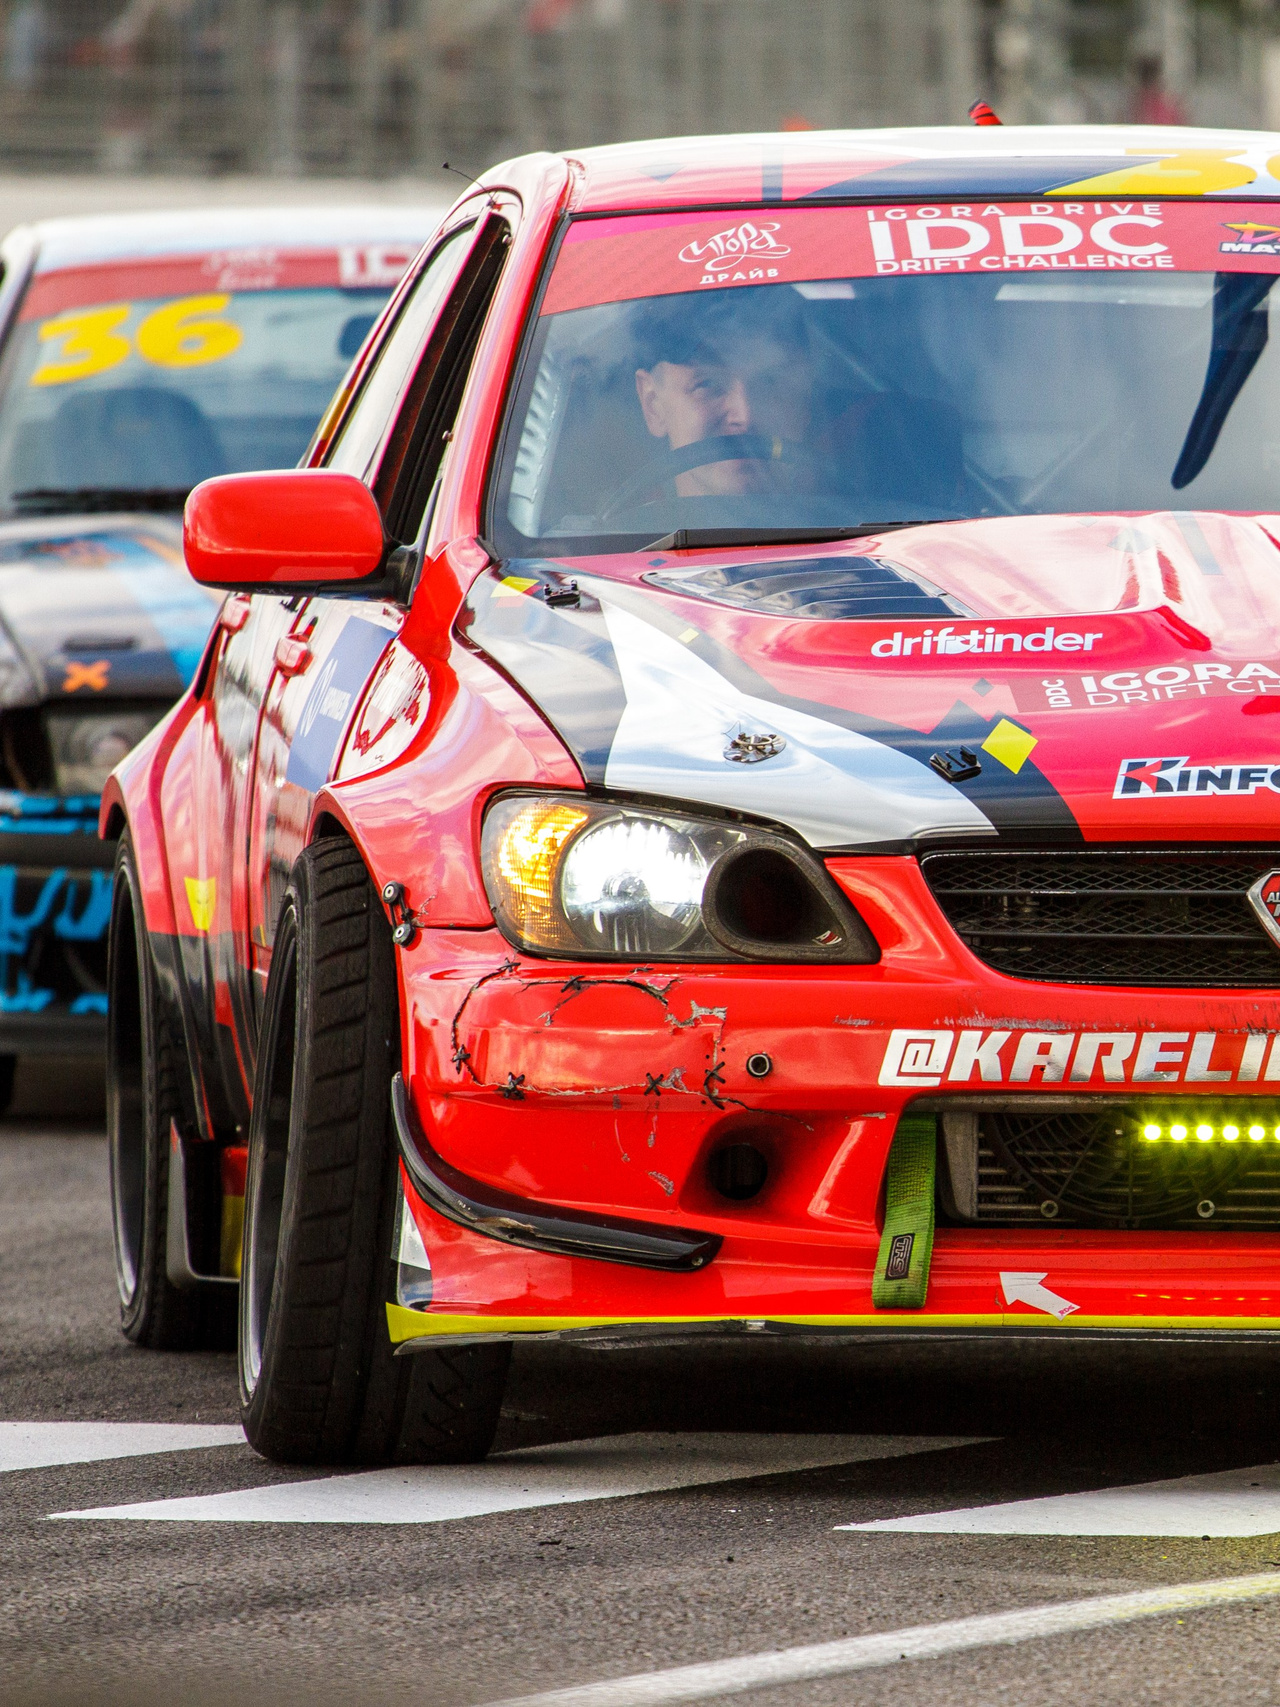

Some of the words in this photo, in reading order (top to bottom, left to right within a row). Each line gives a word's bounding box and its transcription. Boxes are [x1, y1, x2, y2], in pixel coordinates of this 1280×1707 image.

[867, 205, 1005, 221] IGORA
[1030, 203, 1163, 216] DRIVE
[868, 215, 1169, 260] IDDC
[700, 268, 779, 285] ДРАЙВ
[876, 257, 971, 273] DRIFT
[980, 255, 1175, 270] CHALLENGE
[29, 292, 244, 387] 36
[870, 627, 1103, 658] driftinder
[1041, 678, 1072, 708] IDDC
[1087, 681, 1215, 707] DRIFT
[892, 1237, 909, 1273] TRS
